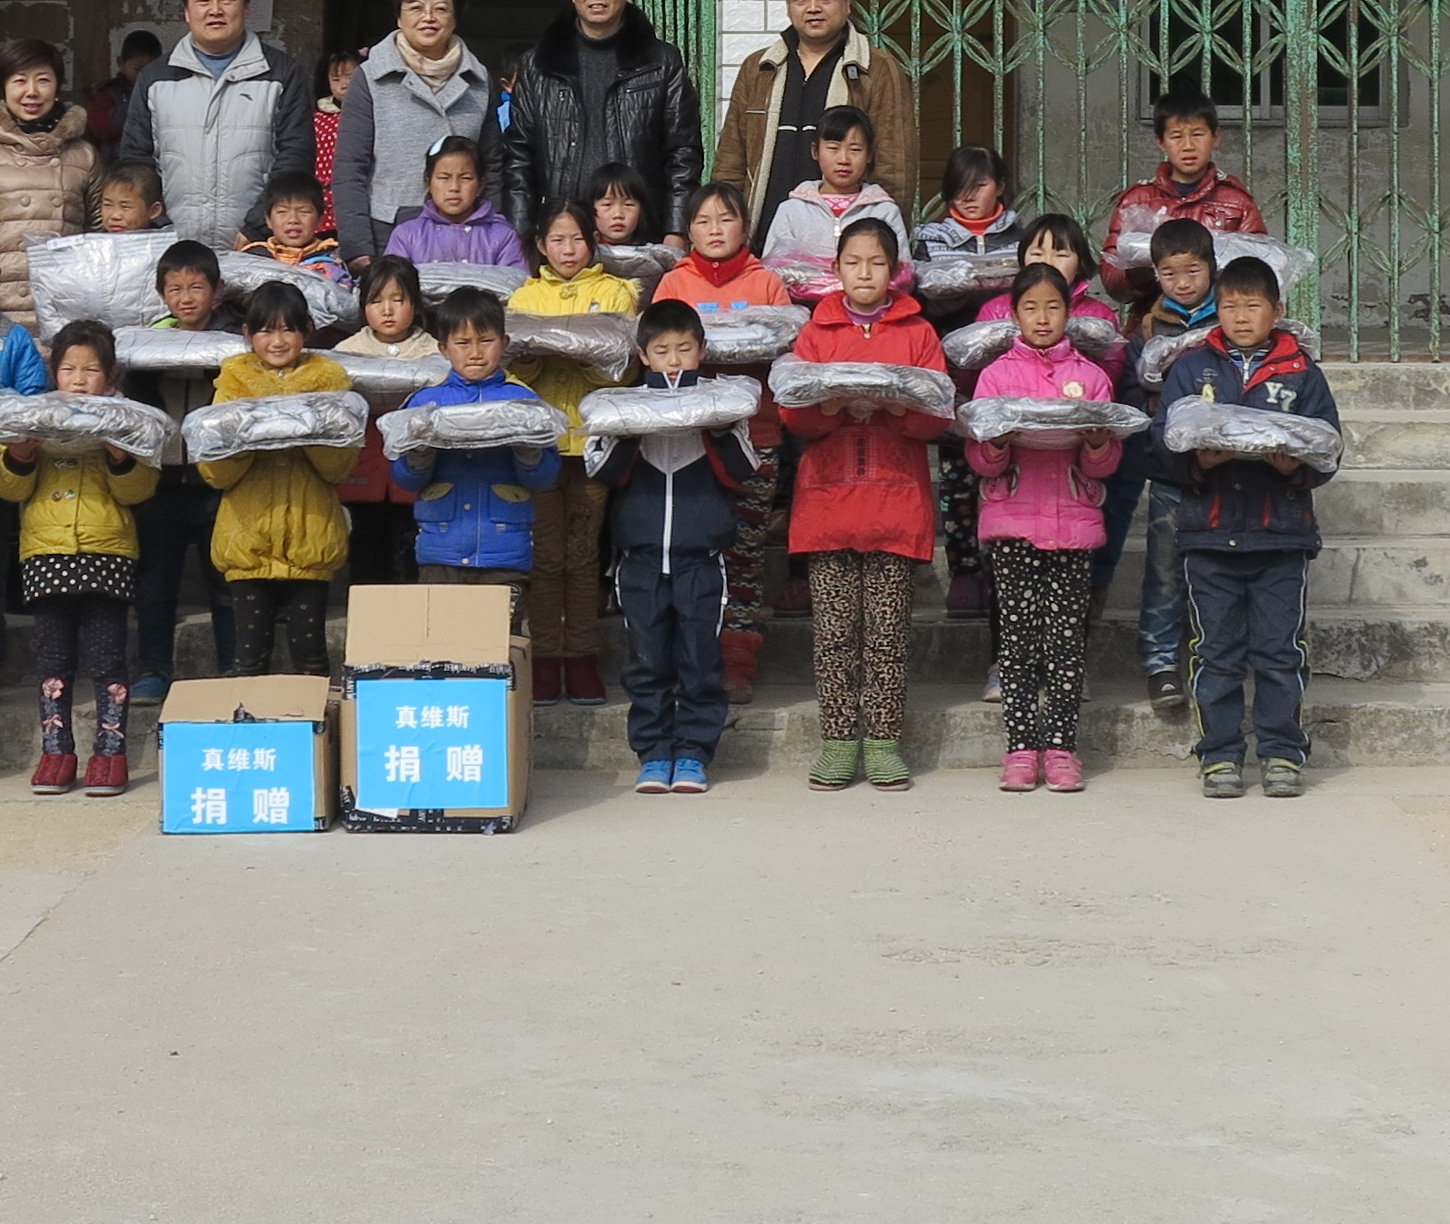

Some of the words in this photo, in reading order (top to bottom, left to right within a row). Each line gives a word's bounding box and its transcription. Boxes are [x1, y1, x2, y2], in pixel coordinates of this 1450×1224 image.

[395, 705, 470, 729] 真维斯
[202, 748, 277, 771] 真维斯
[384, 744, 484, 783] 捐赠
[190, 786, 290, 825] 捐赠
